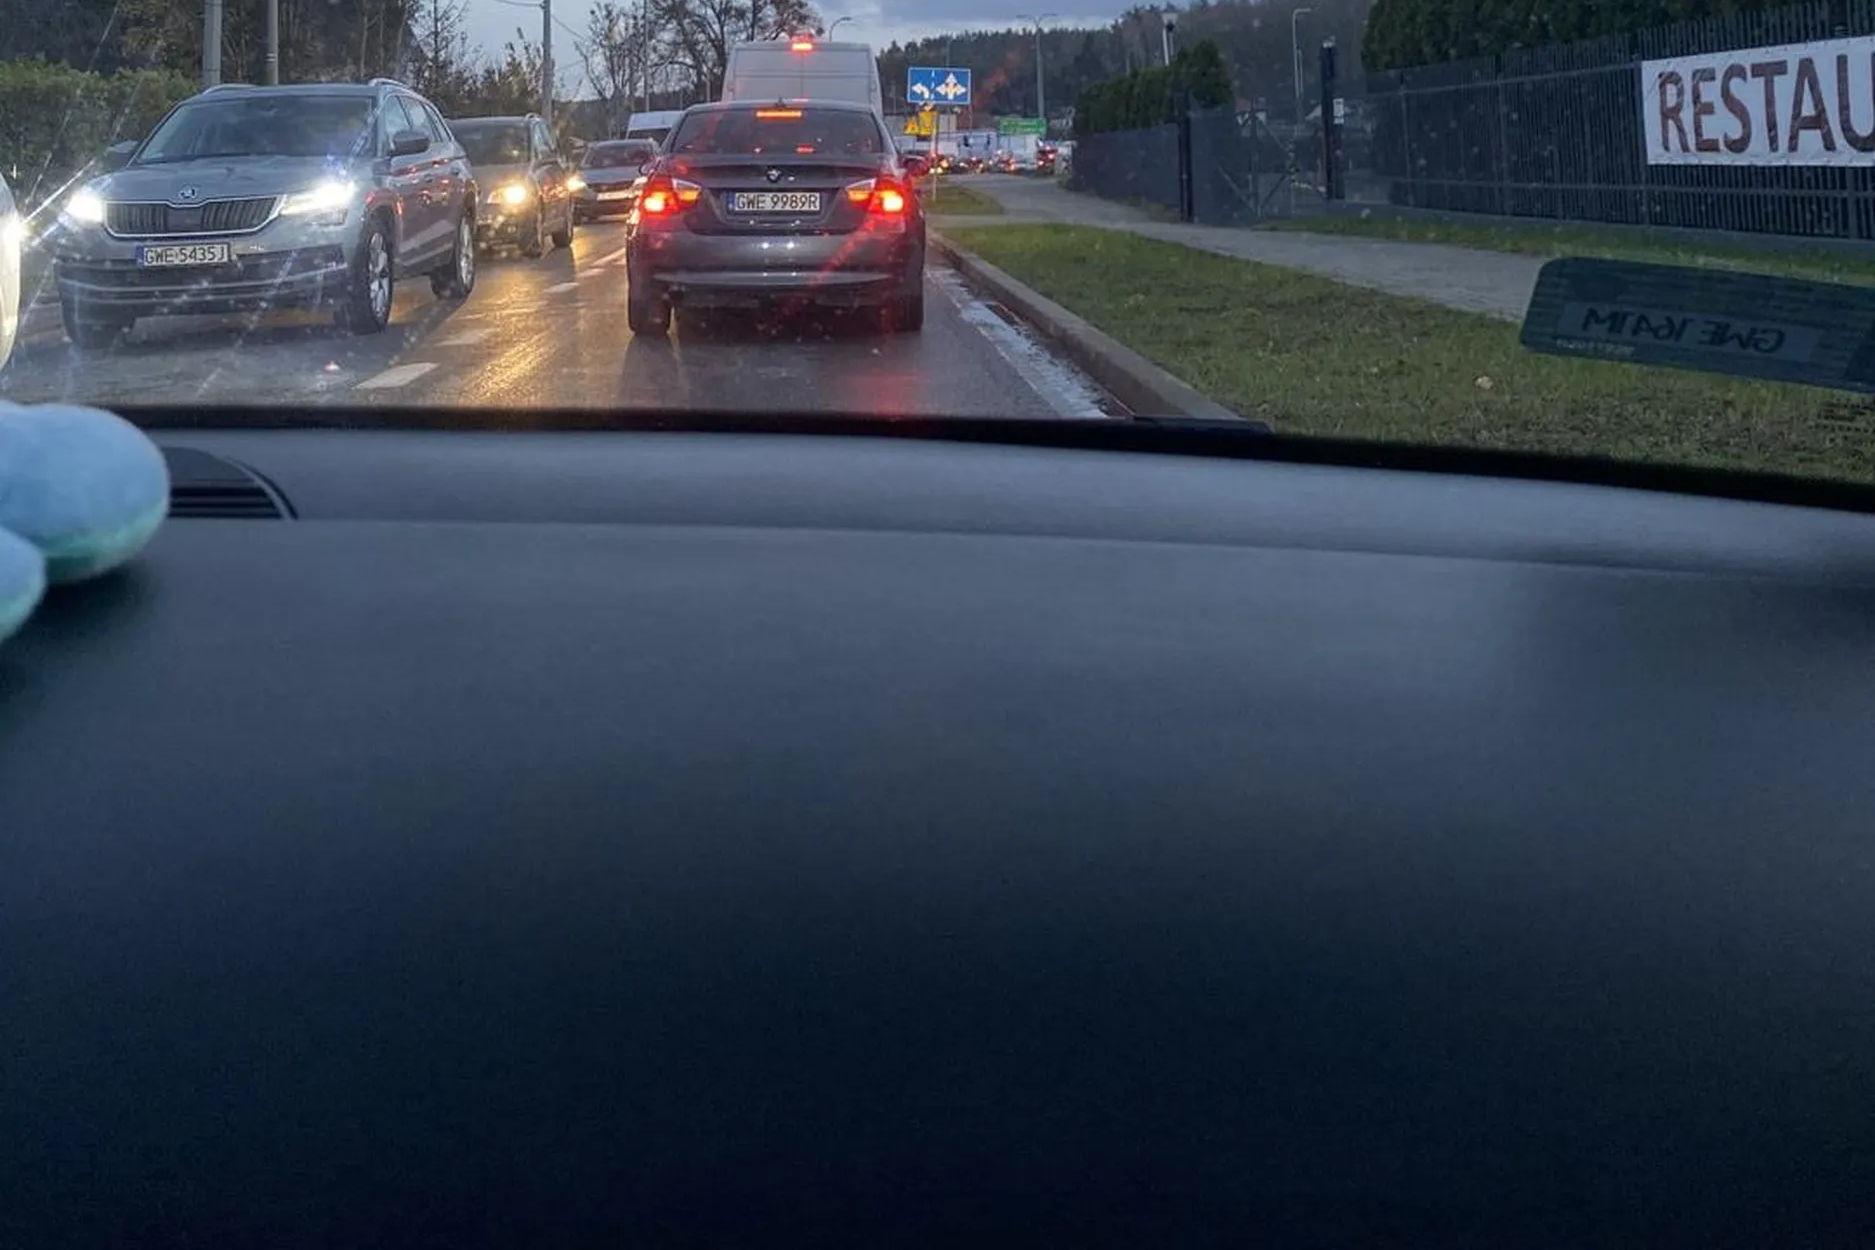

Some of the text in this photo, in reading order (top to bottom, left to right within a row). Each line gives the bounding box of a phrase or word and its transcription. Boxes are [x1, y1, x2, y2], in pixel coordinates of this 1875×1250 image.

[1658, 53, 1875, 154] RESTAU
[737, 193, 818, 210] GWE 9989R
[145, 247, 174, 263] GWE
